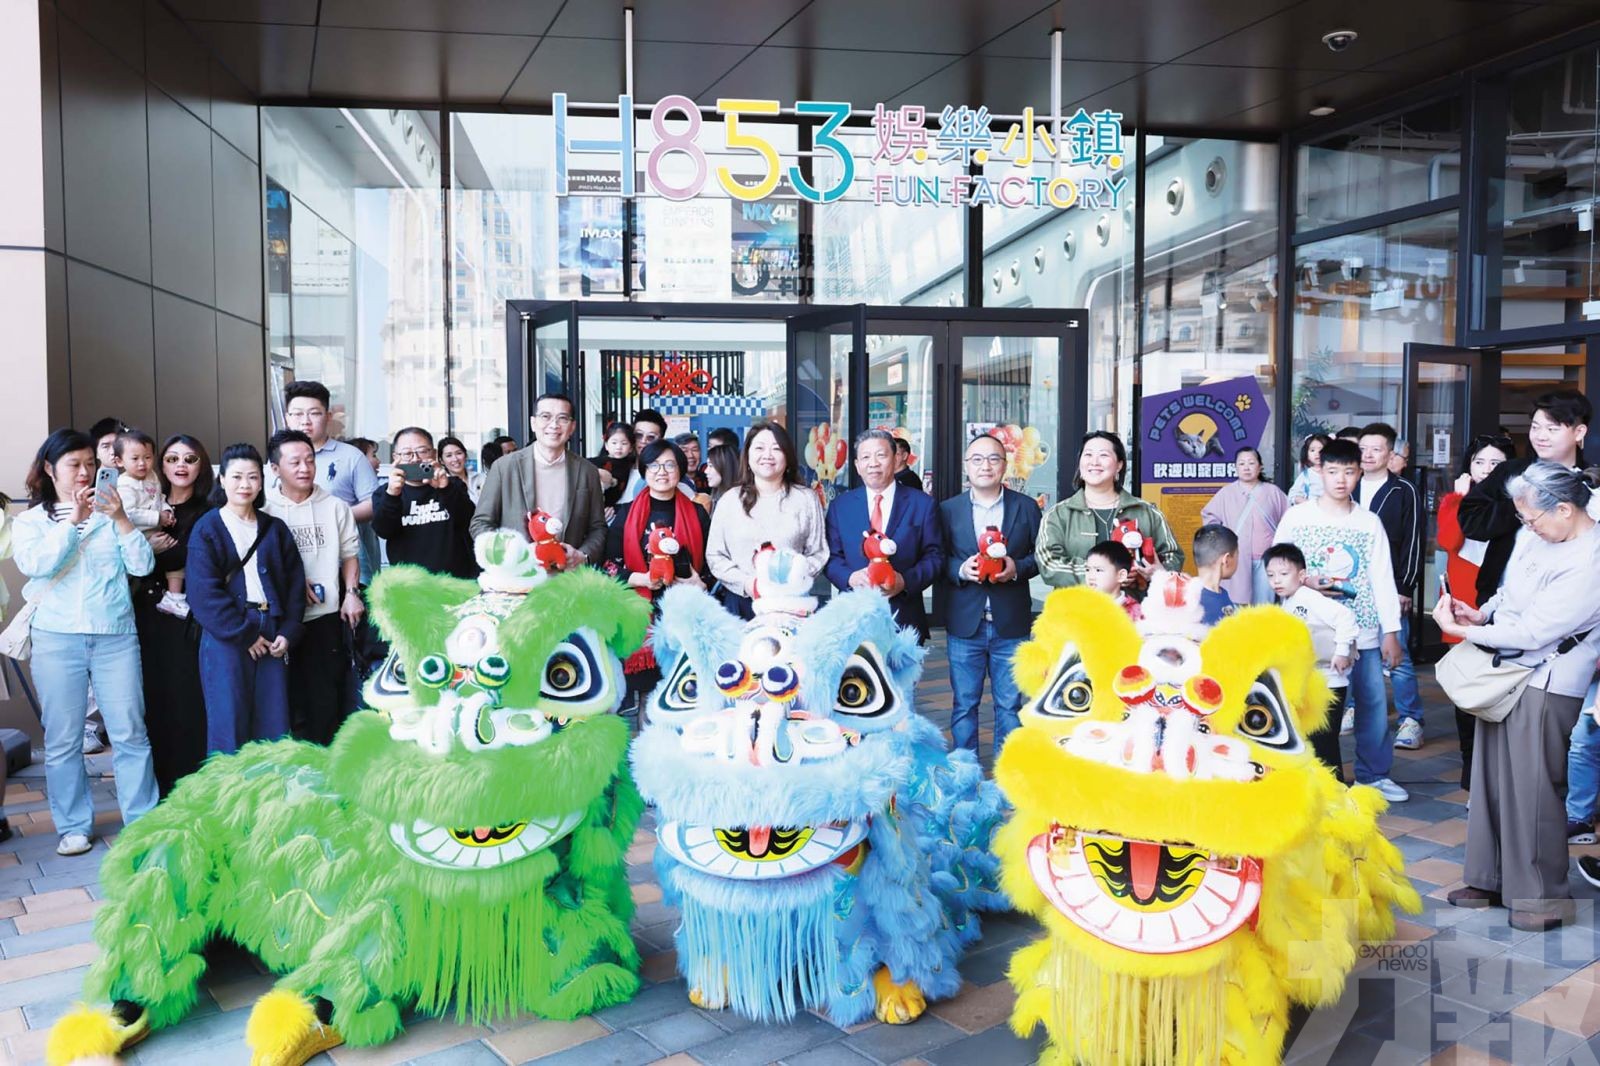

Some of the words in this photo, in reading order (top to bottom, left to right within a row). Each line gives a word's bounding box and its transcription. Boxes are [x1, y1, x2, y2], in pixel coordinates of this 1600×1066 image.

[552, 93, 854, 203] H853
[871, 103, 1125, 168] 娛樂小鎮
[586, 175, 616, 183] IMAX
[872, 175, 940, 206] FUN
[948, 176, 1128, 209] FACTORY
[1149, 401, 1182, 441] PETS
[1183, 395, 1246, 440] WELCOME
